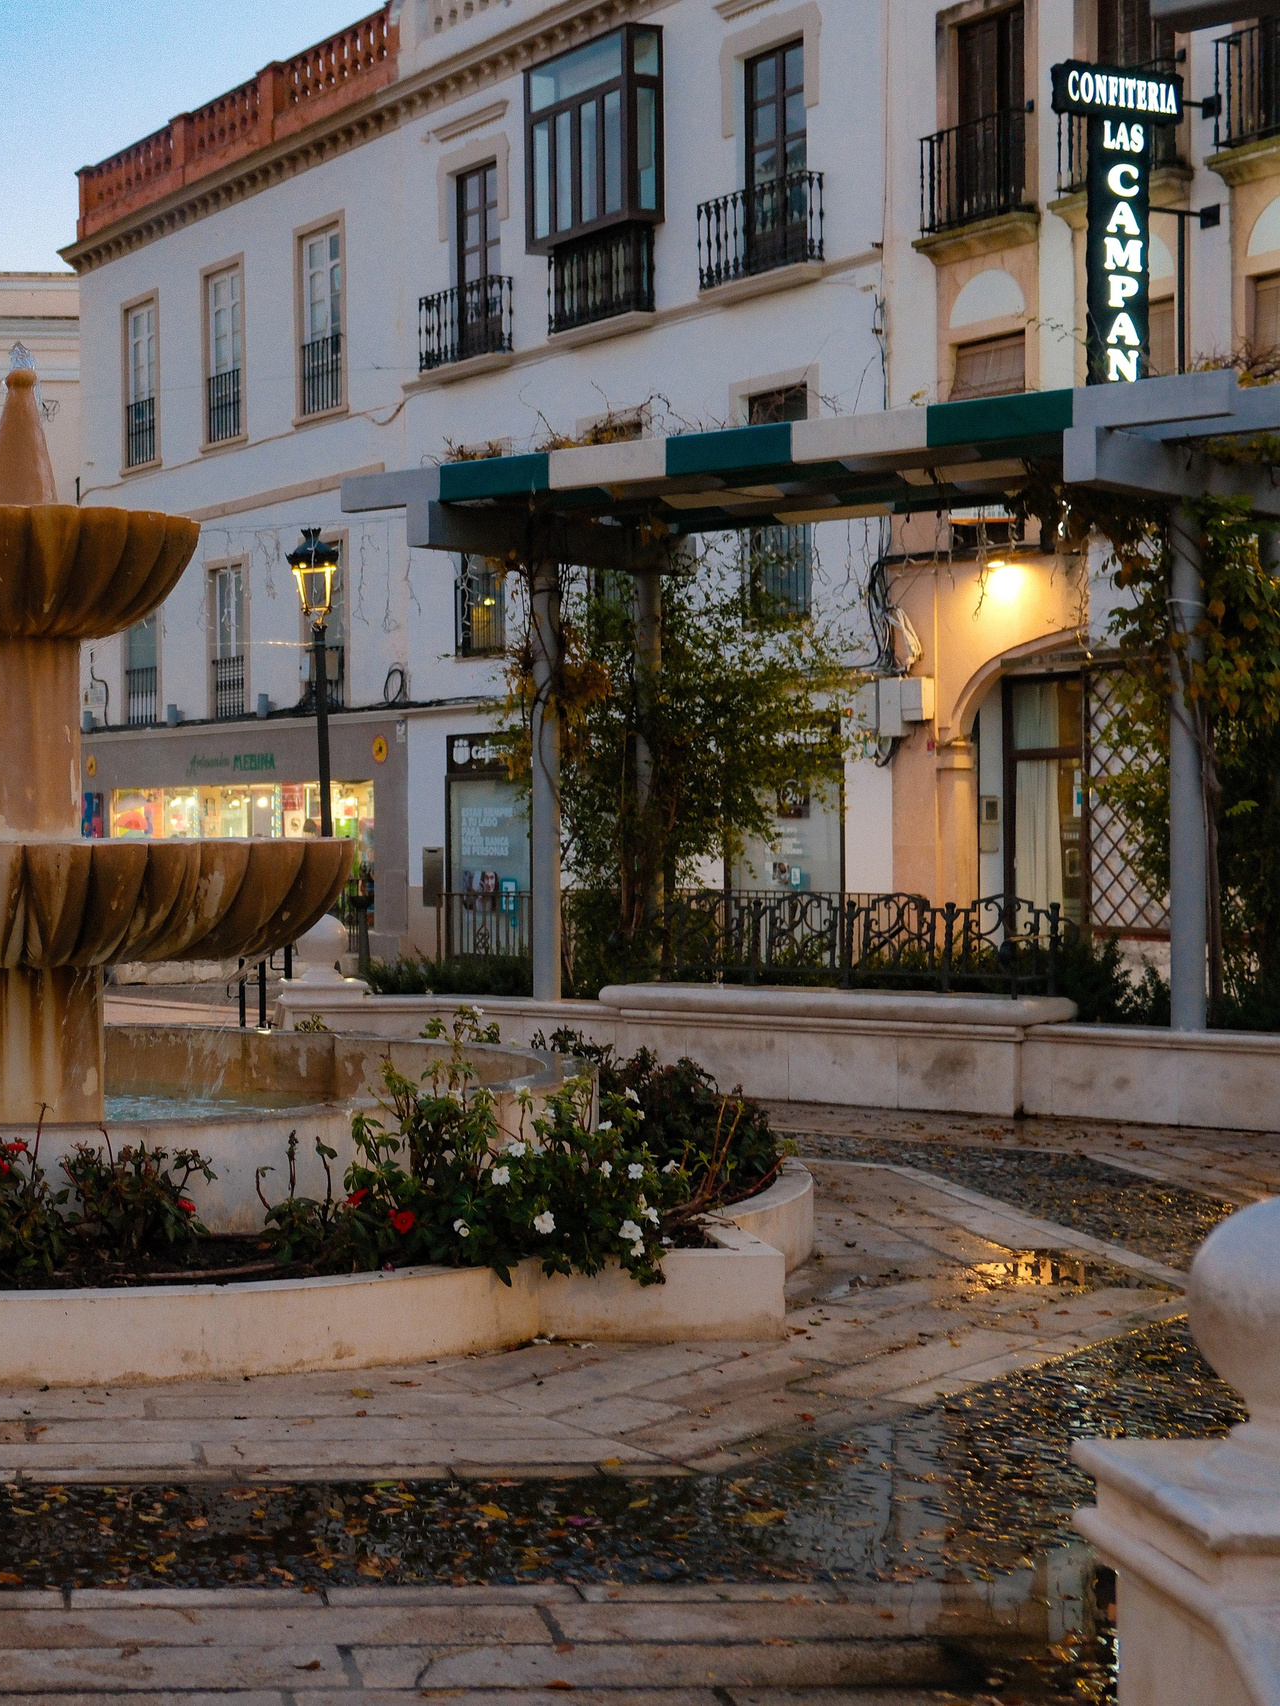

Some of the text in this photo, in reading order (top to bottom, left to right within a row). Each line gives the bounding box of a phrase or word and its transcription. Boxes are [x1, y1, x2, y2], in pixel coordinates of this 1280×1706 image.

[1067, 70, 1178, 115] CONFITERIA
[1103, 120, 1144, 153] LAS
[478, 817, 497, 827] LADO
[472, 846, 509, 856] PERSONAS
